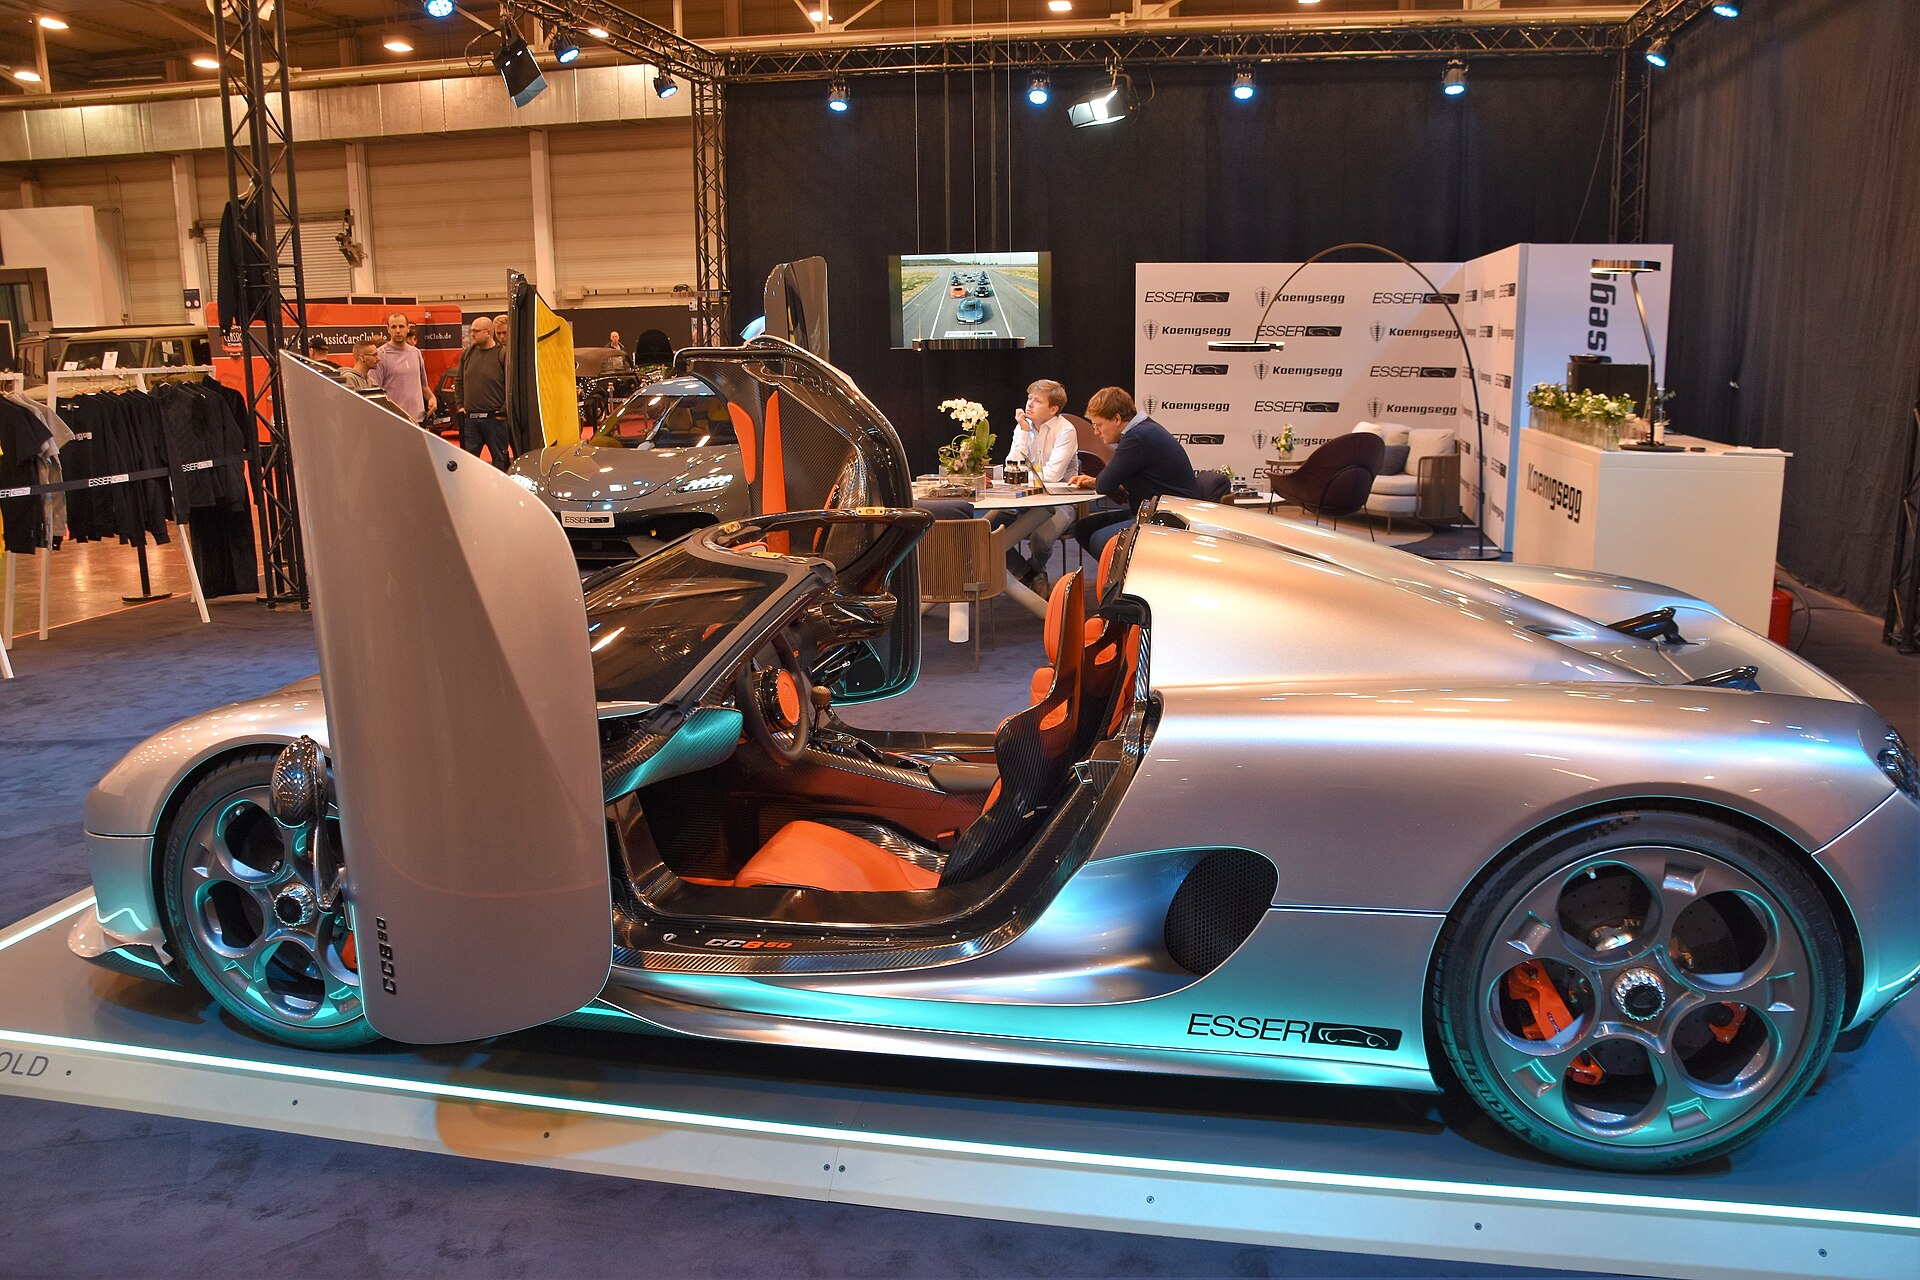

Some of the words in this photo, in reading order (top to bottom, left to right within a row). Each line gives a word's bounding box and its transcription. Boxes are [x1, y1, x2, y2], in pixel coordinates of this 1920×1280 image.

[1144, 291, 1193, 303] ESSER
[1274, 293, 1345, 304] Koenigsegg
[1372, 292, 1423, 304] ESSER
[1161, 326, 1232, 336] Koenigsegg
[1257, 325, 1306, 337] ESSER
[1388, 327, 1461, 339] Koenigsegg
[1144, 363, 1193, 375] ESSER
[1272, 366, 1343, 377] Koenigsegg
[1369, 365, 1420, 378] ESSER
[1161, 401, 1230, 412] Koenigsegg
[1254, 401, 1303, 412] ESSER
[1386, 404, 1457, 416] Koenigsegg
[88, 476, 113, 487] ESSER
[1527, 462, 1582, 524] Koenigsegg
[565, 516, 590, 524] ESSER
[1186, 1012, 1311, 1043] ESSER
